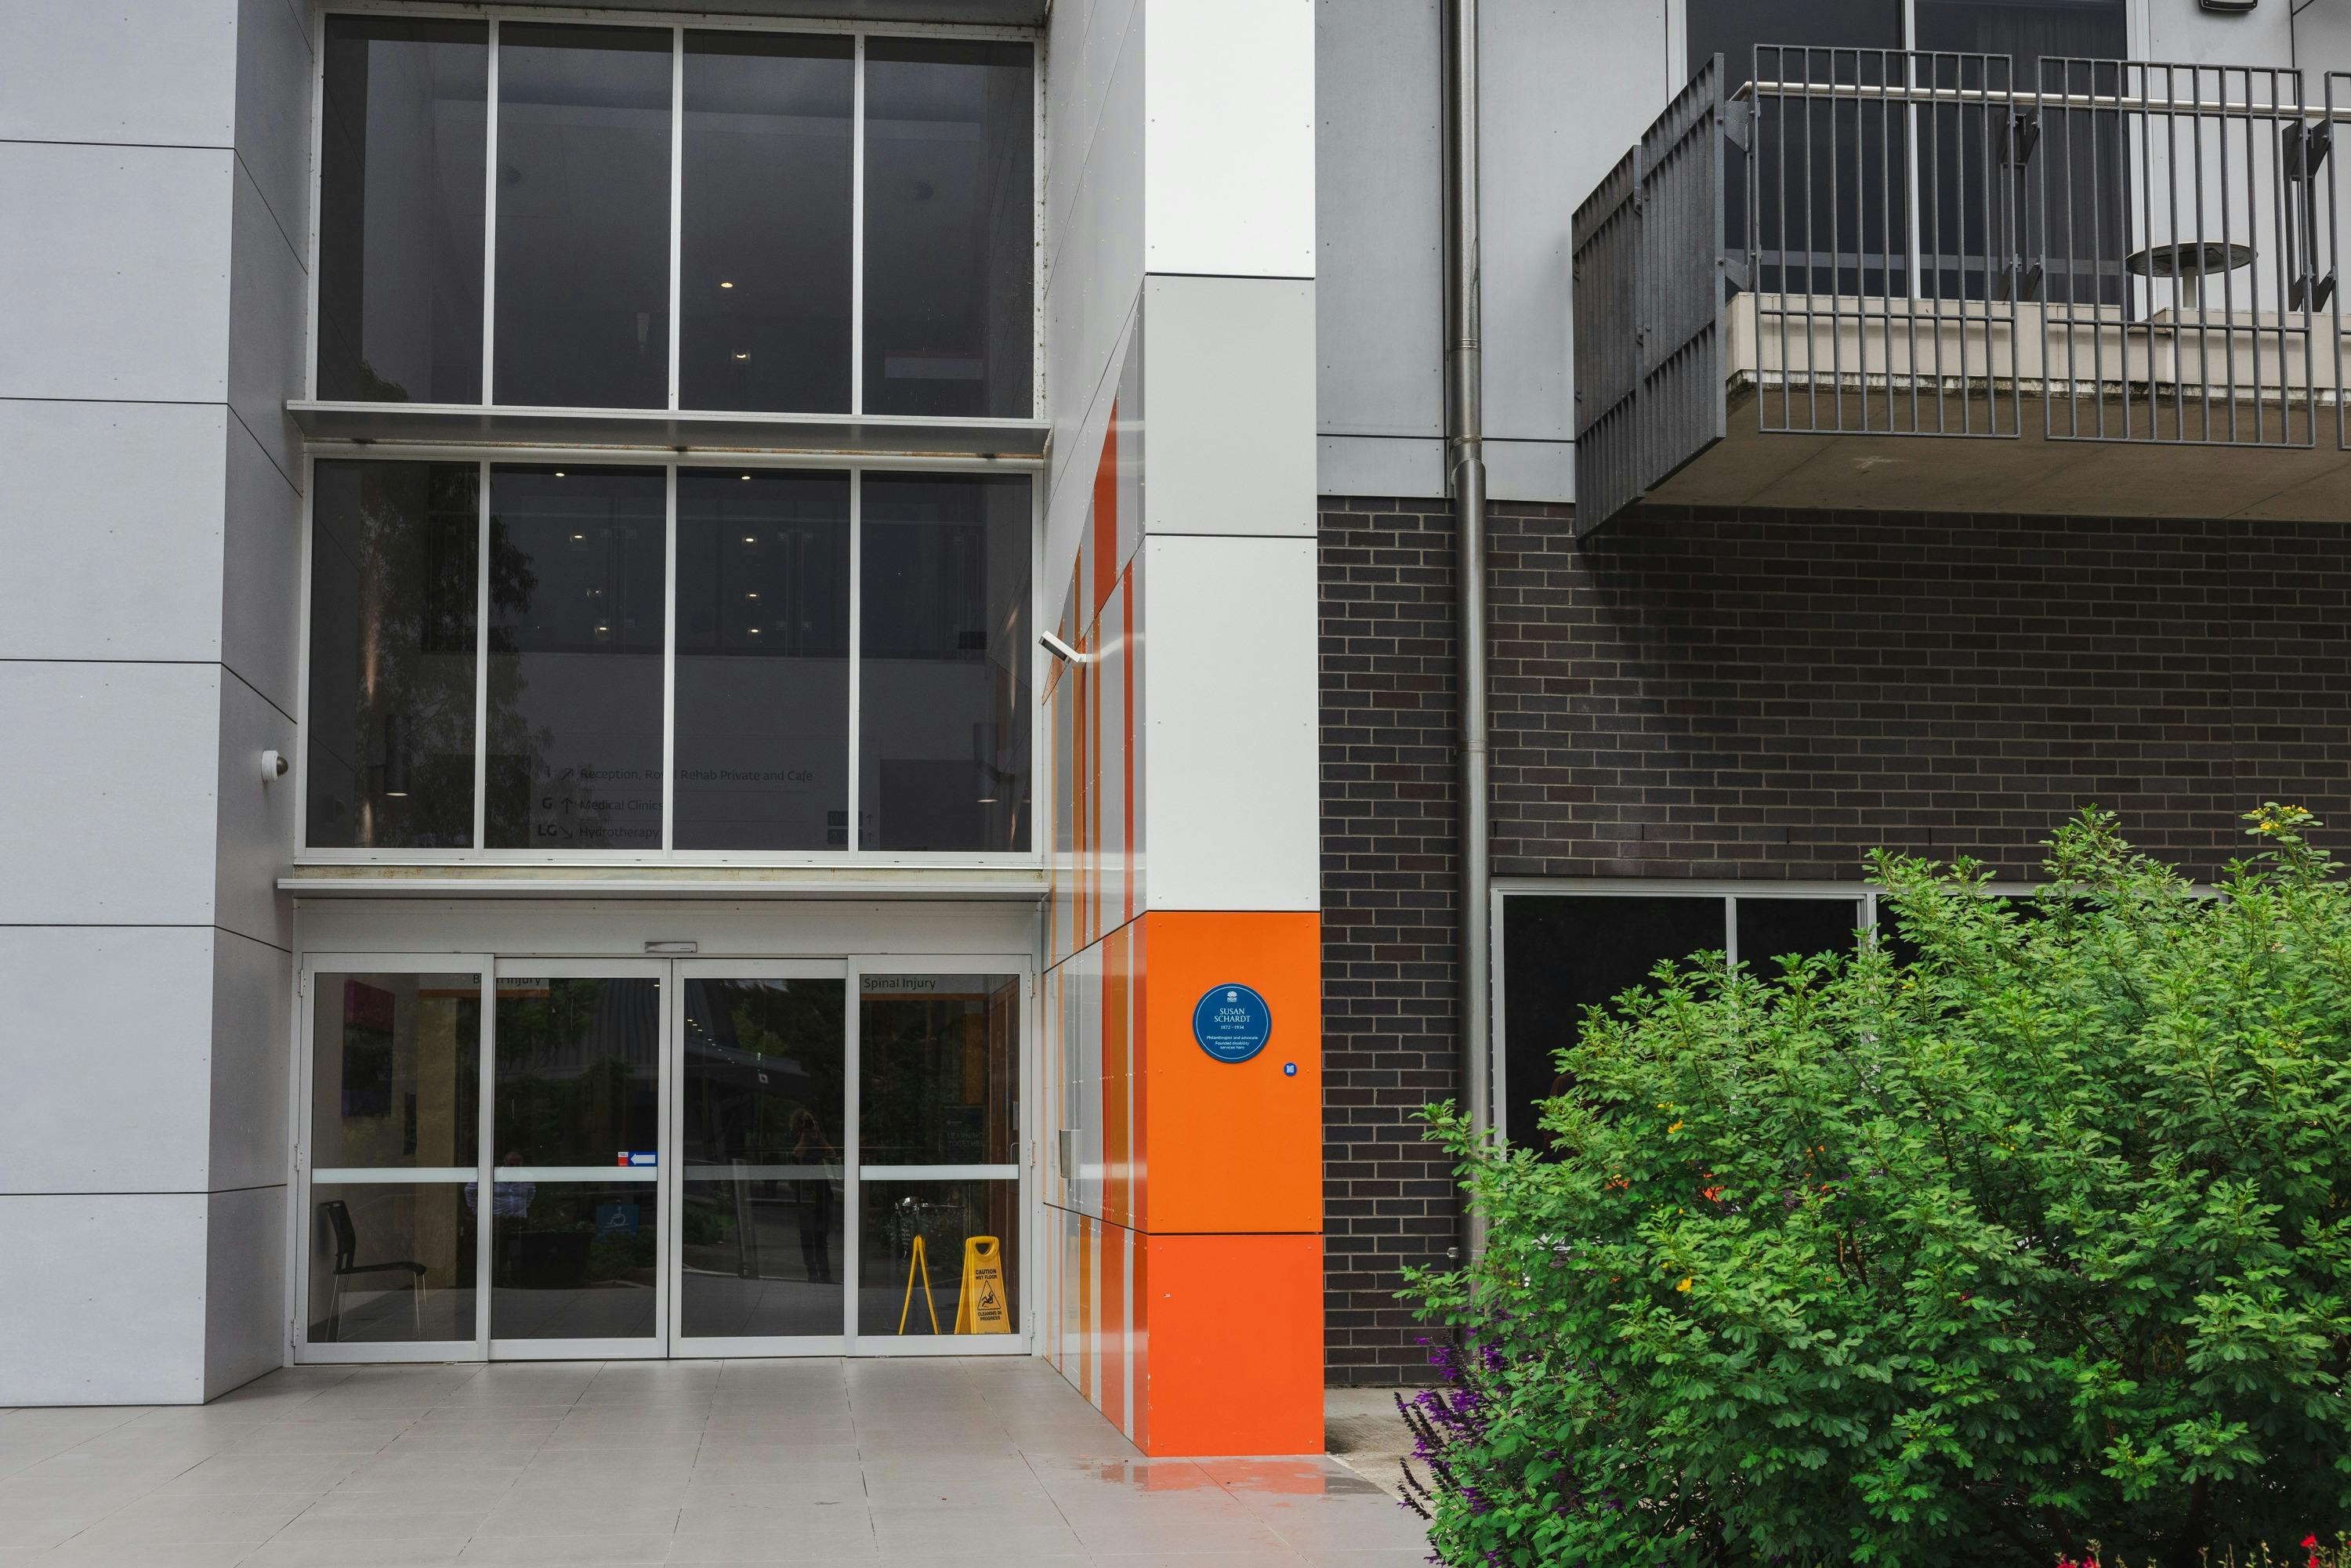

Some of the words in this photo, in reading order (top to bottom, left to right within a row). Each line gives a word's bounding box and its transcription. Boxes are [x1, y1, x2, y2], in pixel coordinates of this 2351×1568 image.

[581, 769, 642, 781] Reception,
[646, 770, 676, 780] Rol
[680, 770, 717, 780] Rehab
[720, 770, 760, 780] Private
[763, 770, 784, 780] and
[787, 770, 813, 783] Cafe
[542, 797, 552, 809] G
[580, 799, 624, 810] Medical
[628, 799, 663, 810] Clinics
[538, 824, 557, 836] LG
[580, 826, 659, 840] Hydrotherapy
[864, 977, 899, 990] Spinal
[903, 977, 936, 990] Injury
